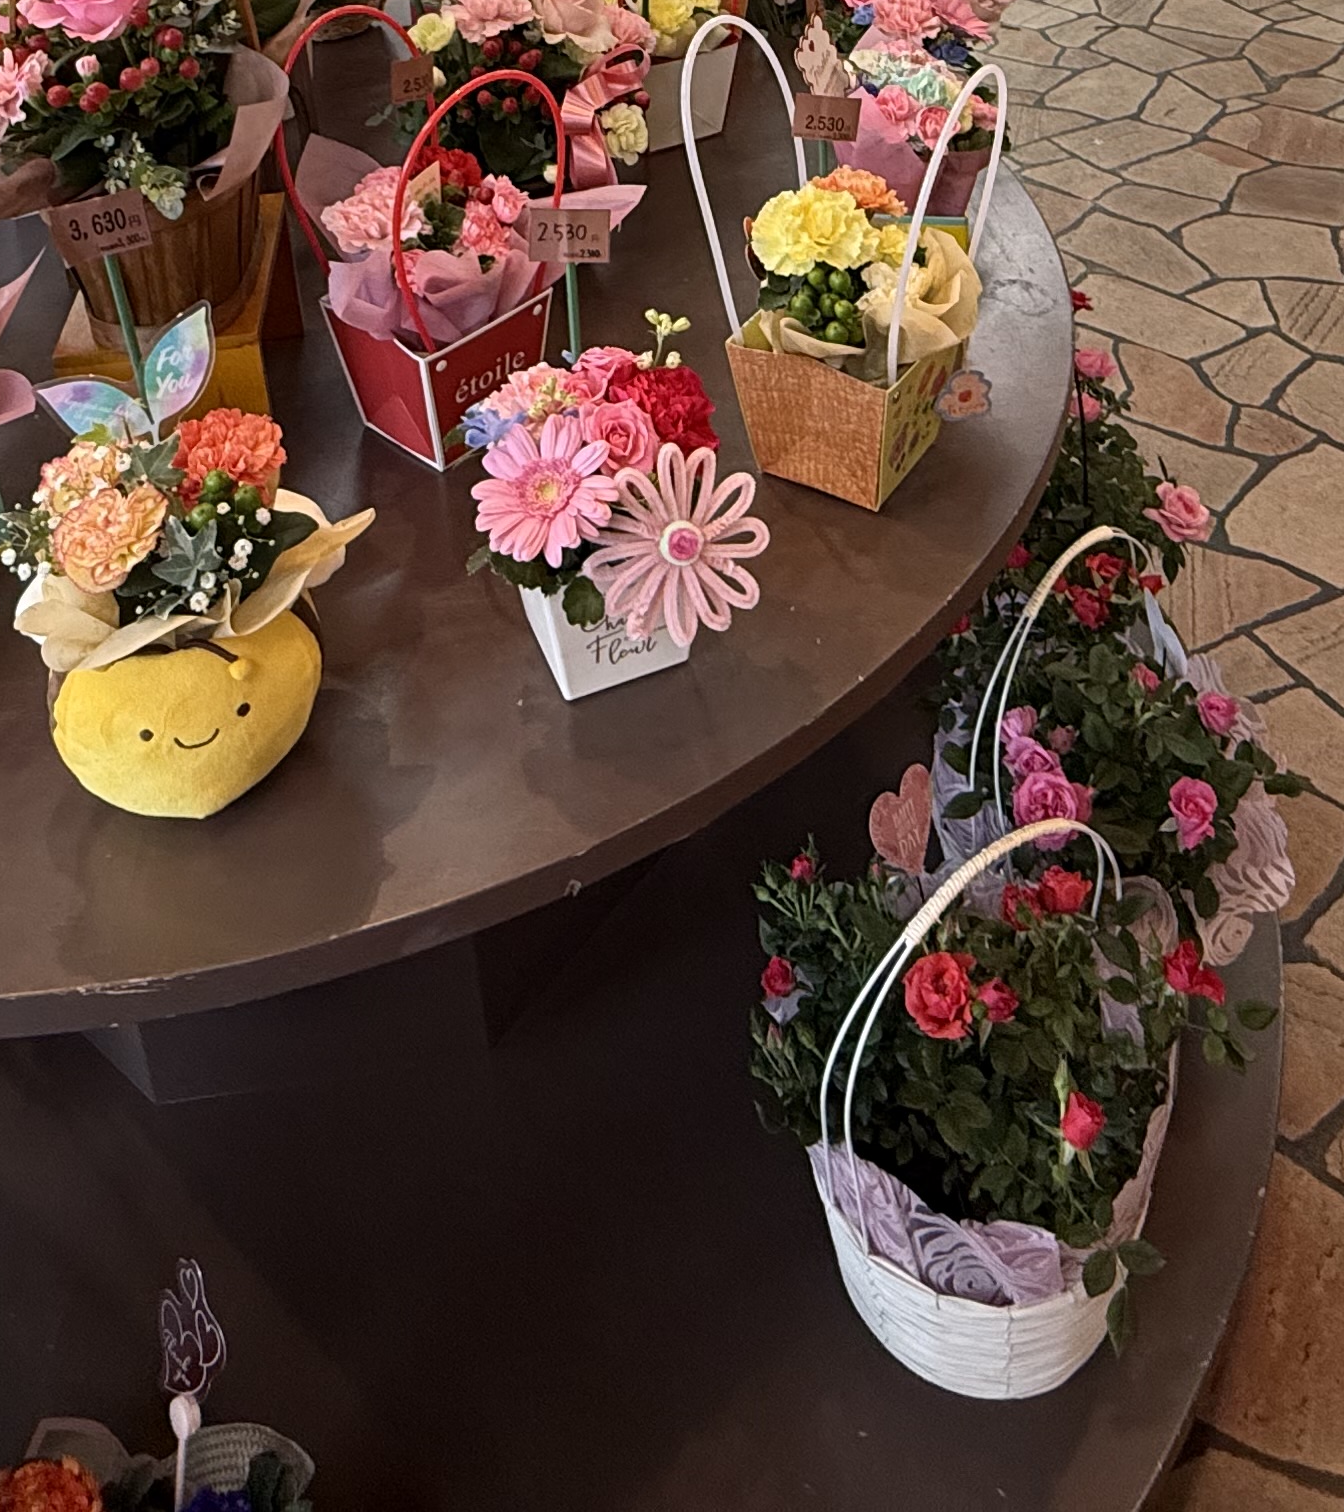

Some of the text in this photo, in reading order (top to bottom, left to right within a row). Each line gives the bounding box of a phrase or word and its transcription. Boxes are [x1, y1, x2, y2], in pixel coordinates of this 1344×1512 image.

[157, 344, 196, 372] For
[156, 372, 192, 399] You
[456, 351, 526, 404] étoile
